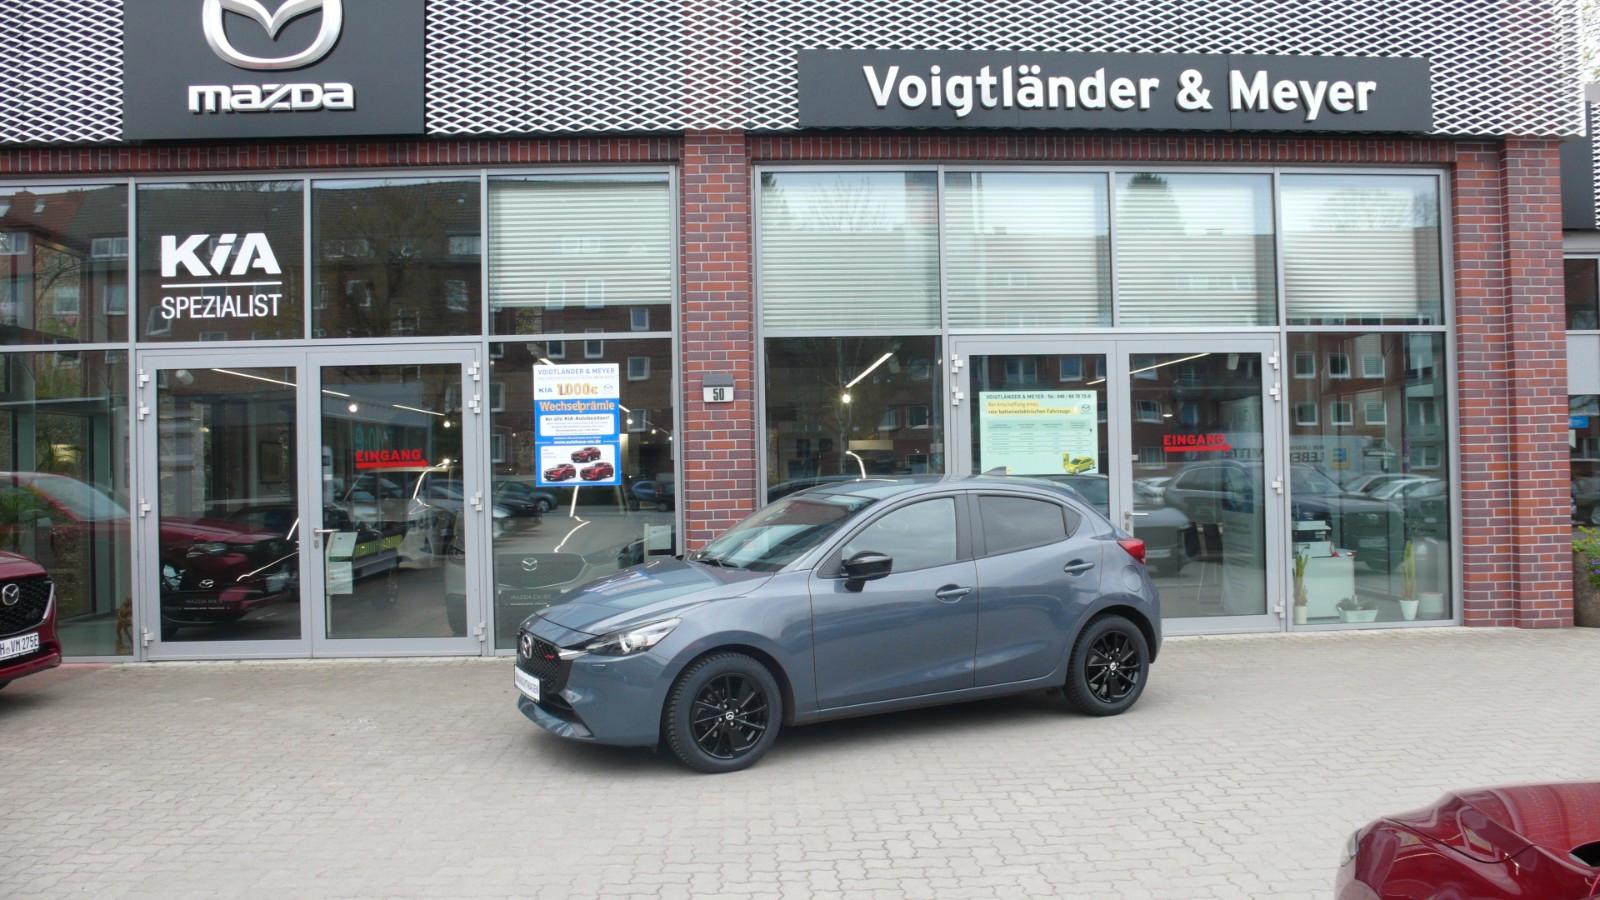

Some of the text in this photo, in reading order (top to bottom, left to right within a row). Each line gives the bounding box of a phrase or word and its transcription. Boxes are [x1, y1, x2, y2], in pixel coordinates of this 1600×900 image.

[862, 64, 1377, 122] Voigtländer & Meyer
[161, 294, 283, 319] SPEZIALIST
[713, 388, 725, 401] 50
[540, 401, 615, 413] Wechselprämie
[1163, 434, 1226, 446] EINGANG
[355, 448, 421, 462] EINGANG
[22, 634, 38, 650] 275E
